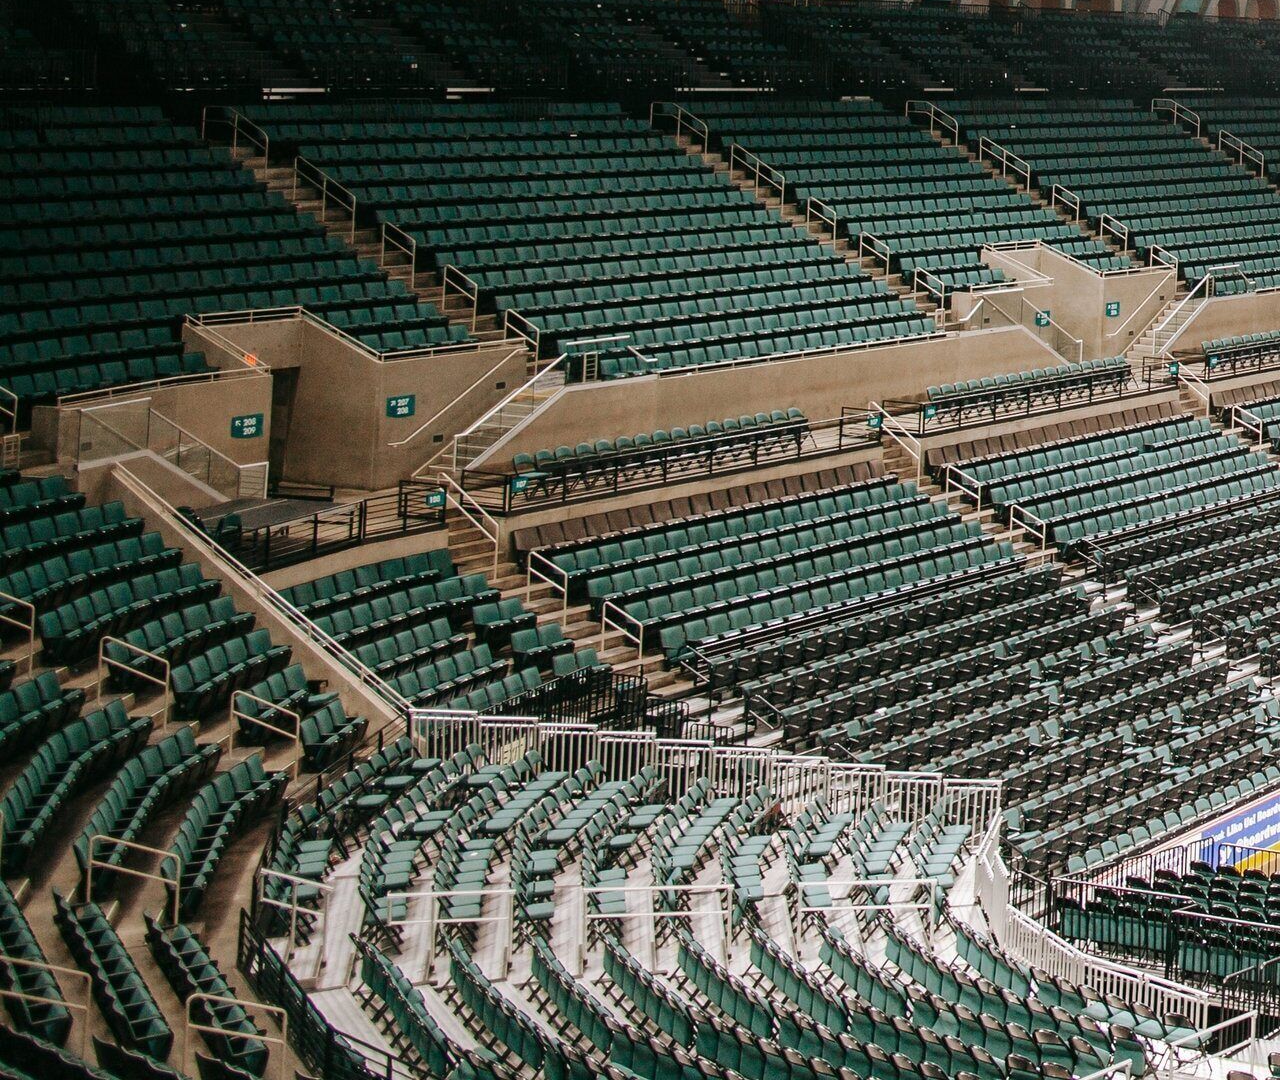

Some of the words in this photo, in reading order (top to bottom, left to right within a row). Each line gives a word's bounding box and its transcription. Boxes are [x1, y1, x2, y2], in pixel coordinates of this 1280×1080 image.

[243, 426, 257, 436] 209
[1227, 821, 1243, 837] Like
[1244, 813, 1257, 828] Us!
